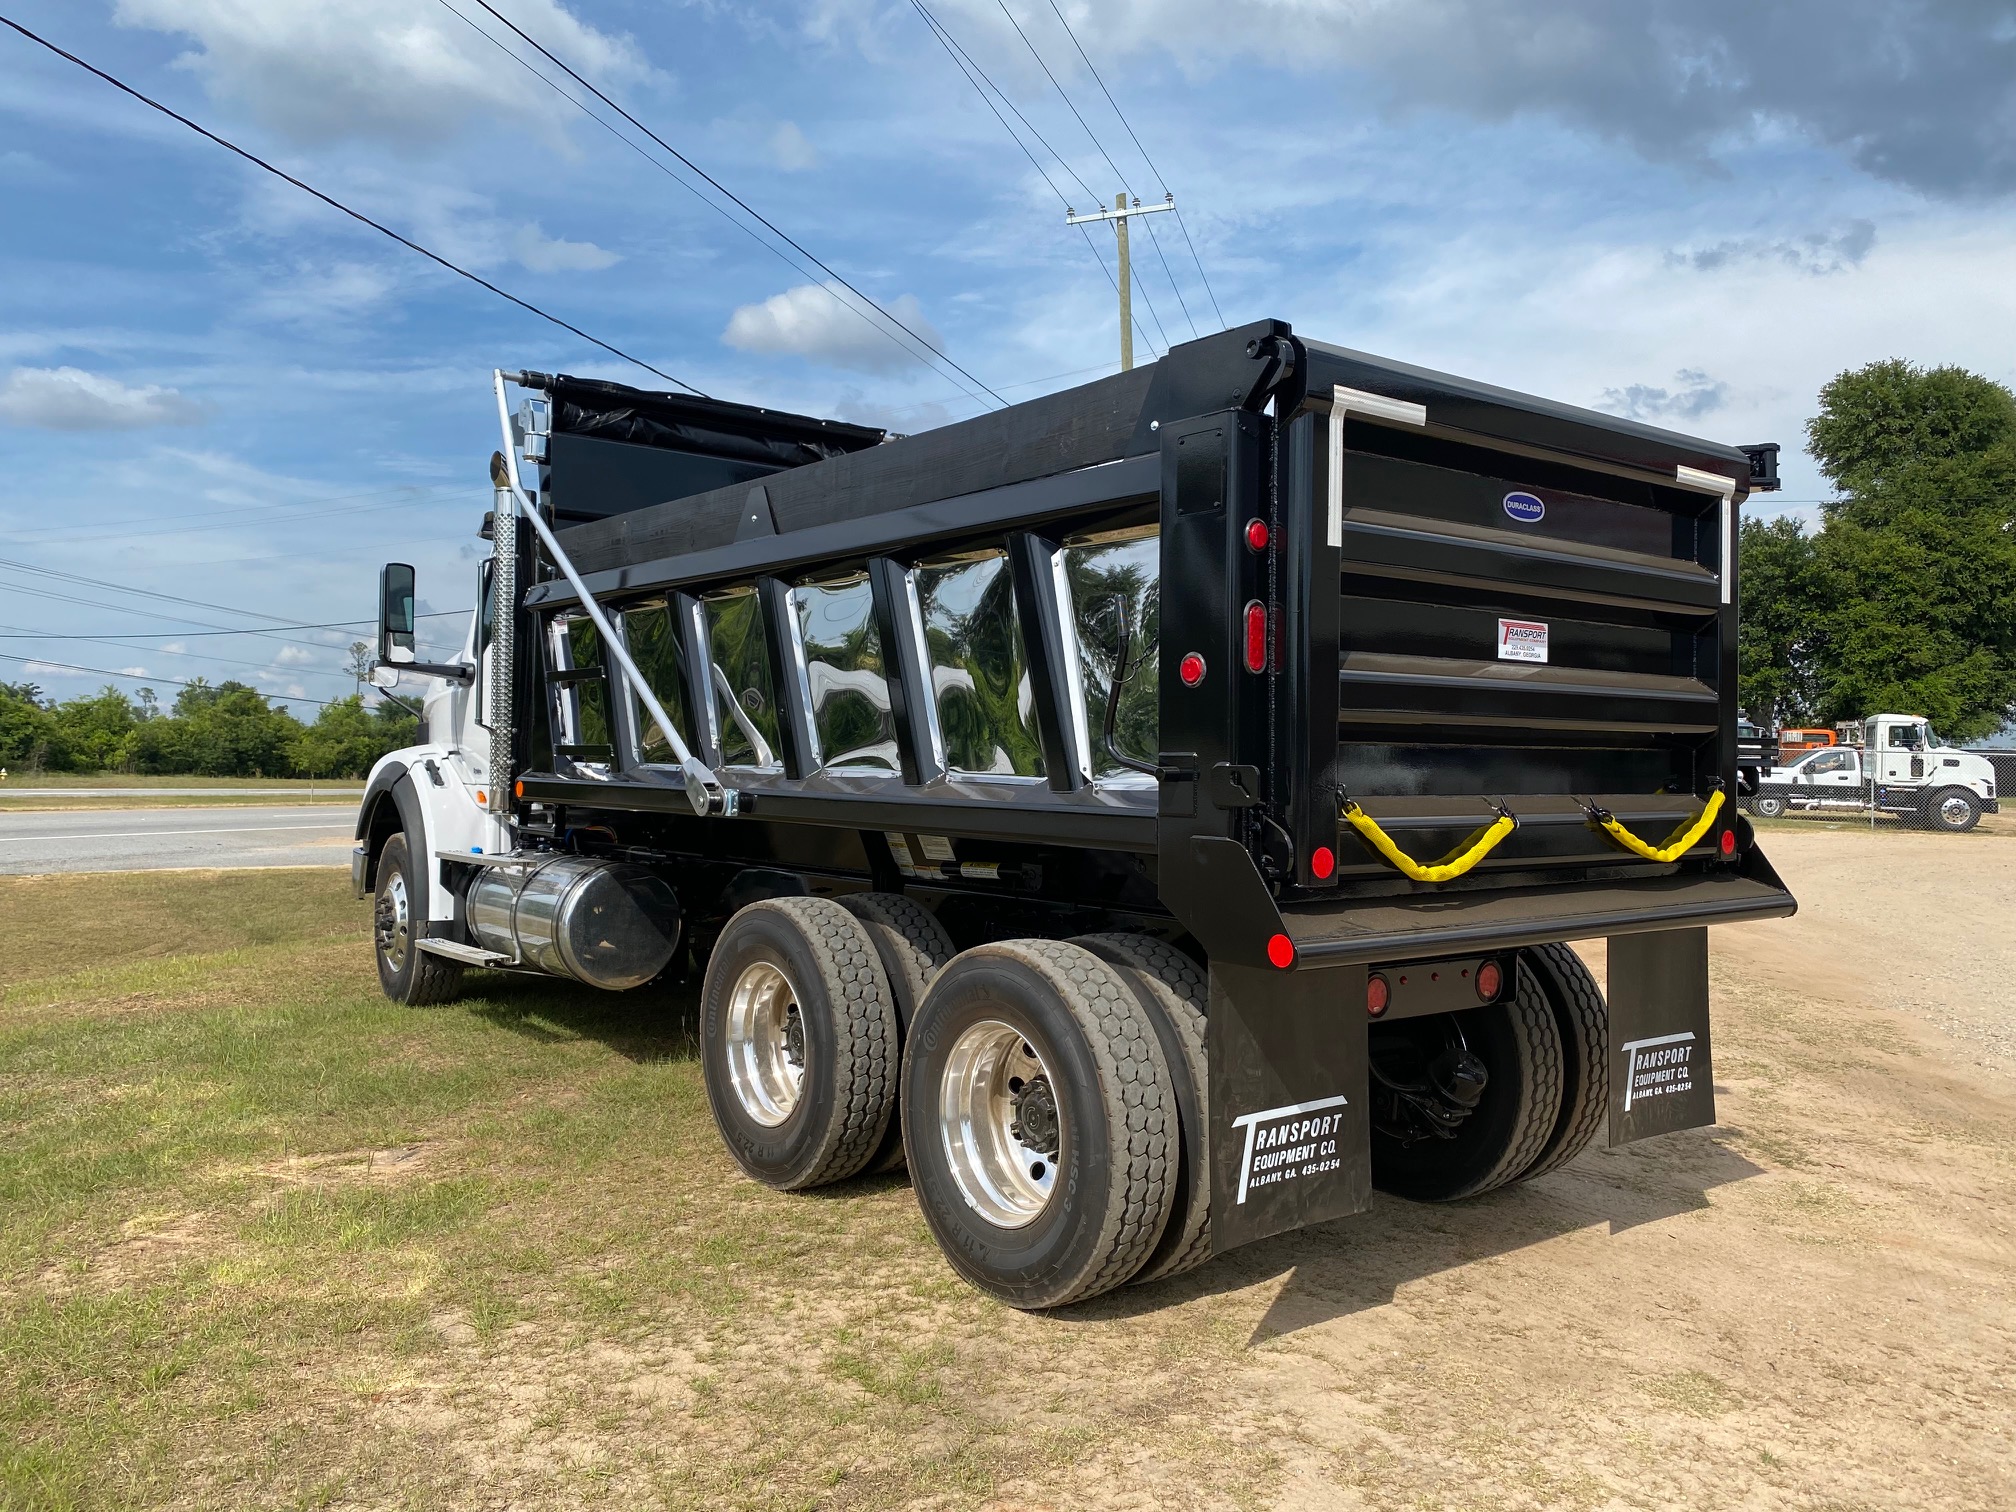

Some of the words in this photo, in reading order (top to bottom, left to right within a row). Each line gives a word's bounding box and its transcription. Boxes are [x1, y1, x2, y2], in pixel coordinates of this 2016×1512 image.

[1507, 500, 1541, 513] DURACLASS
[1499, 620, 1547, 645] TRANSPORT
[1522, 651, 1541, 659] GEORGIA
[1634, 1069, 1675, 1087] EQUIPMENT
[736, 1132, 755, 1154] 22.5
[1253, 1143, 1317, 1172] EQUIPMENT
[1320, 1139, 1336, 1155] CO.
[1068, 1149, 1080, 1195] HSC
[1249, 1171, 1282, 1188] ALBANY,
[1284, 1168, 1297, 1179] GA.
[1301, 1158, 1341, 1176] 435-0254
[1063, 1197, 1072, 1213] 3
